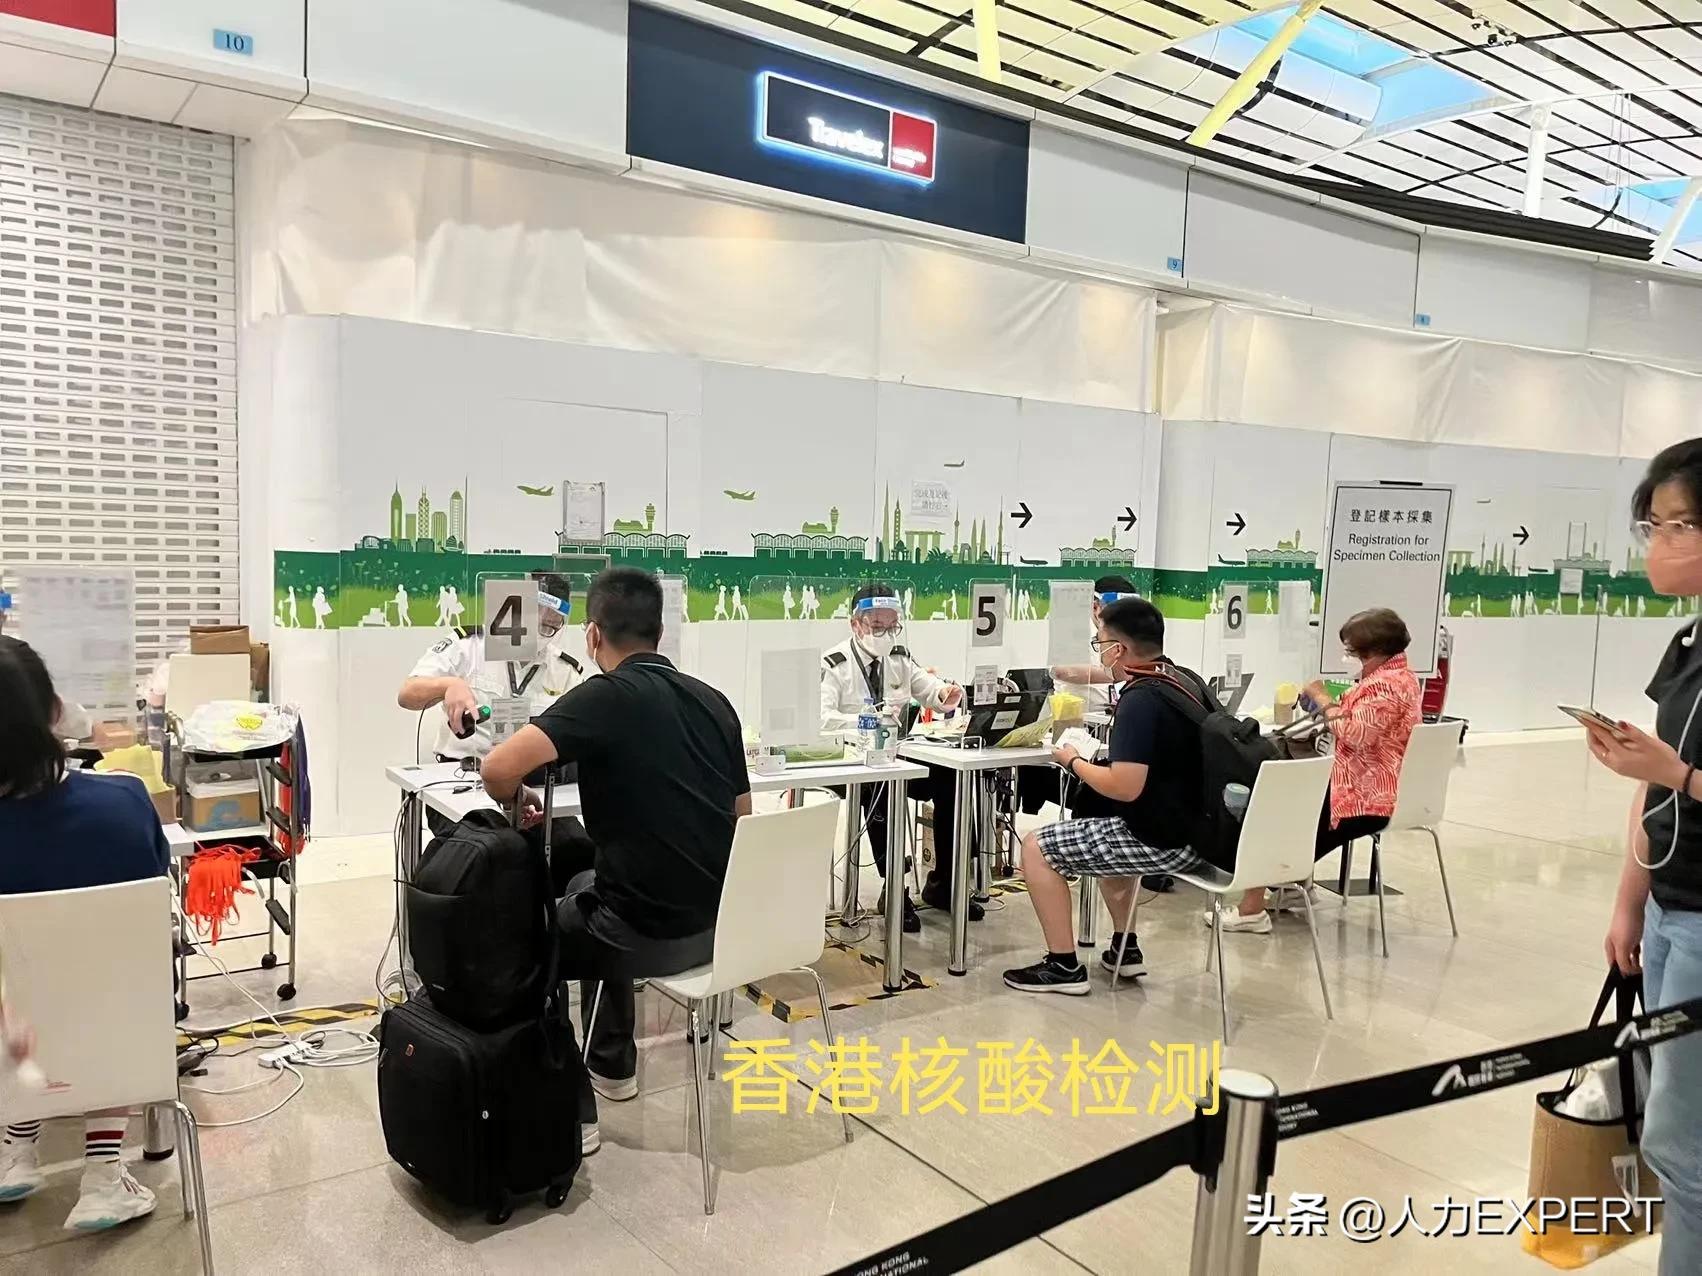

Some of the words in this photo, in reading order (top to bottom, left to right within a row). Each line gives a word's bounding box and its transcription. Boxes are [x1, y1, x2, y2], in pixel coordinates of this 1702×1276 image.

[226, 34, 245, 51] 10
[1348, 532, 1411, 547] Registration
[1414, 534, 1430, 546] for
[1333, 549, 1386, 562] Specimen
[1388, 549, 1441, 562] Collection
[490, 595, 527, 646] 4
[976, 596, 997, 636] 5
[1227, 595, 1242, 630] 6
[881, 1251, 910, 1271] KONG
